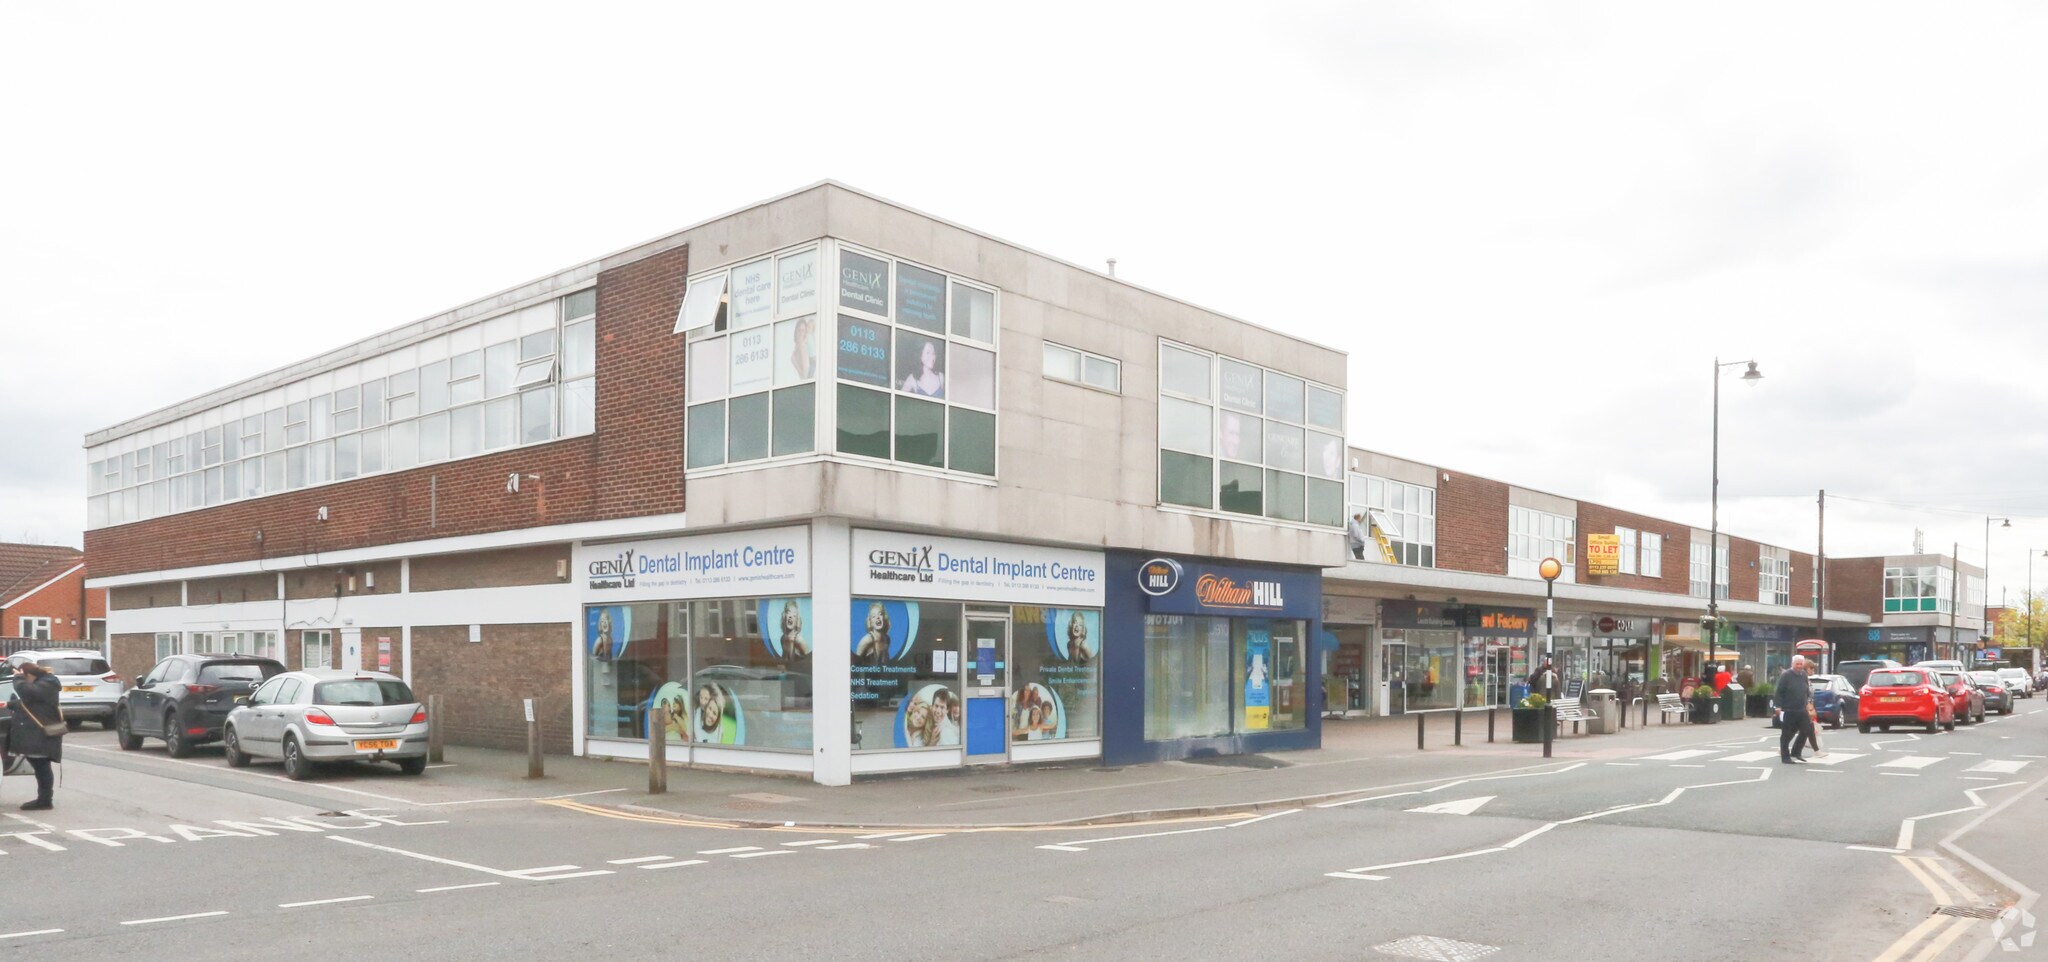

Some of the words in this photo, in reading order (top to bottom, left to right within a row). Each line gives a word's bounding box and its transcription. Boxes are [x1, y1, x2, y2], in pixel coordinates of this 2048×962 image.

[746, 273, 760, 285] NHS
[734, 285, 755, 298] dental
[756, 282, 772, 292] care
[782, 293, 799, 304] Dental
[800, 290, 816, 298] Clinic
[842, 288, 864, 300] Dental
[864, 294, 884, 306] Clinic
[746, 295, 760, 304] here
[743, 334, 761, 348] 0113
[850, 325, 876, 341] 0113
[736, 352, 749, 365] 286
[750, 348, 768, 362] 6133
[840, 340, 858, 354] 286
[861, 344, 885, 360] 6133
[639, 552, 680, 574] Dental
[685, 549, 738, 574] Implant
[743, 545, 794, 567] Centre
[938, 553, 988, 574] Dental
[993, 558, 1046, 580] Implant
[1051, 562, 1095, 582] Centre
[590, 580, 622, 590] Healthcare
[624, 578, 634, 588] Ltd
[870, 570, 916, 582] Healthcare
[920, 573, 933, 582] Ltd
[1149, 575, 1168, 587] HILL
[1196, 574, 1254, 607] William
[1254, 582, 1284, 606] HILL
[1482, 613, 1495, 628] ard
[1497, 613, 1528, 632] Factory
